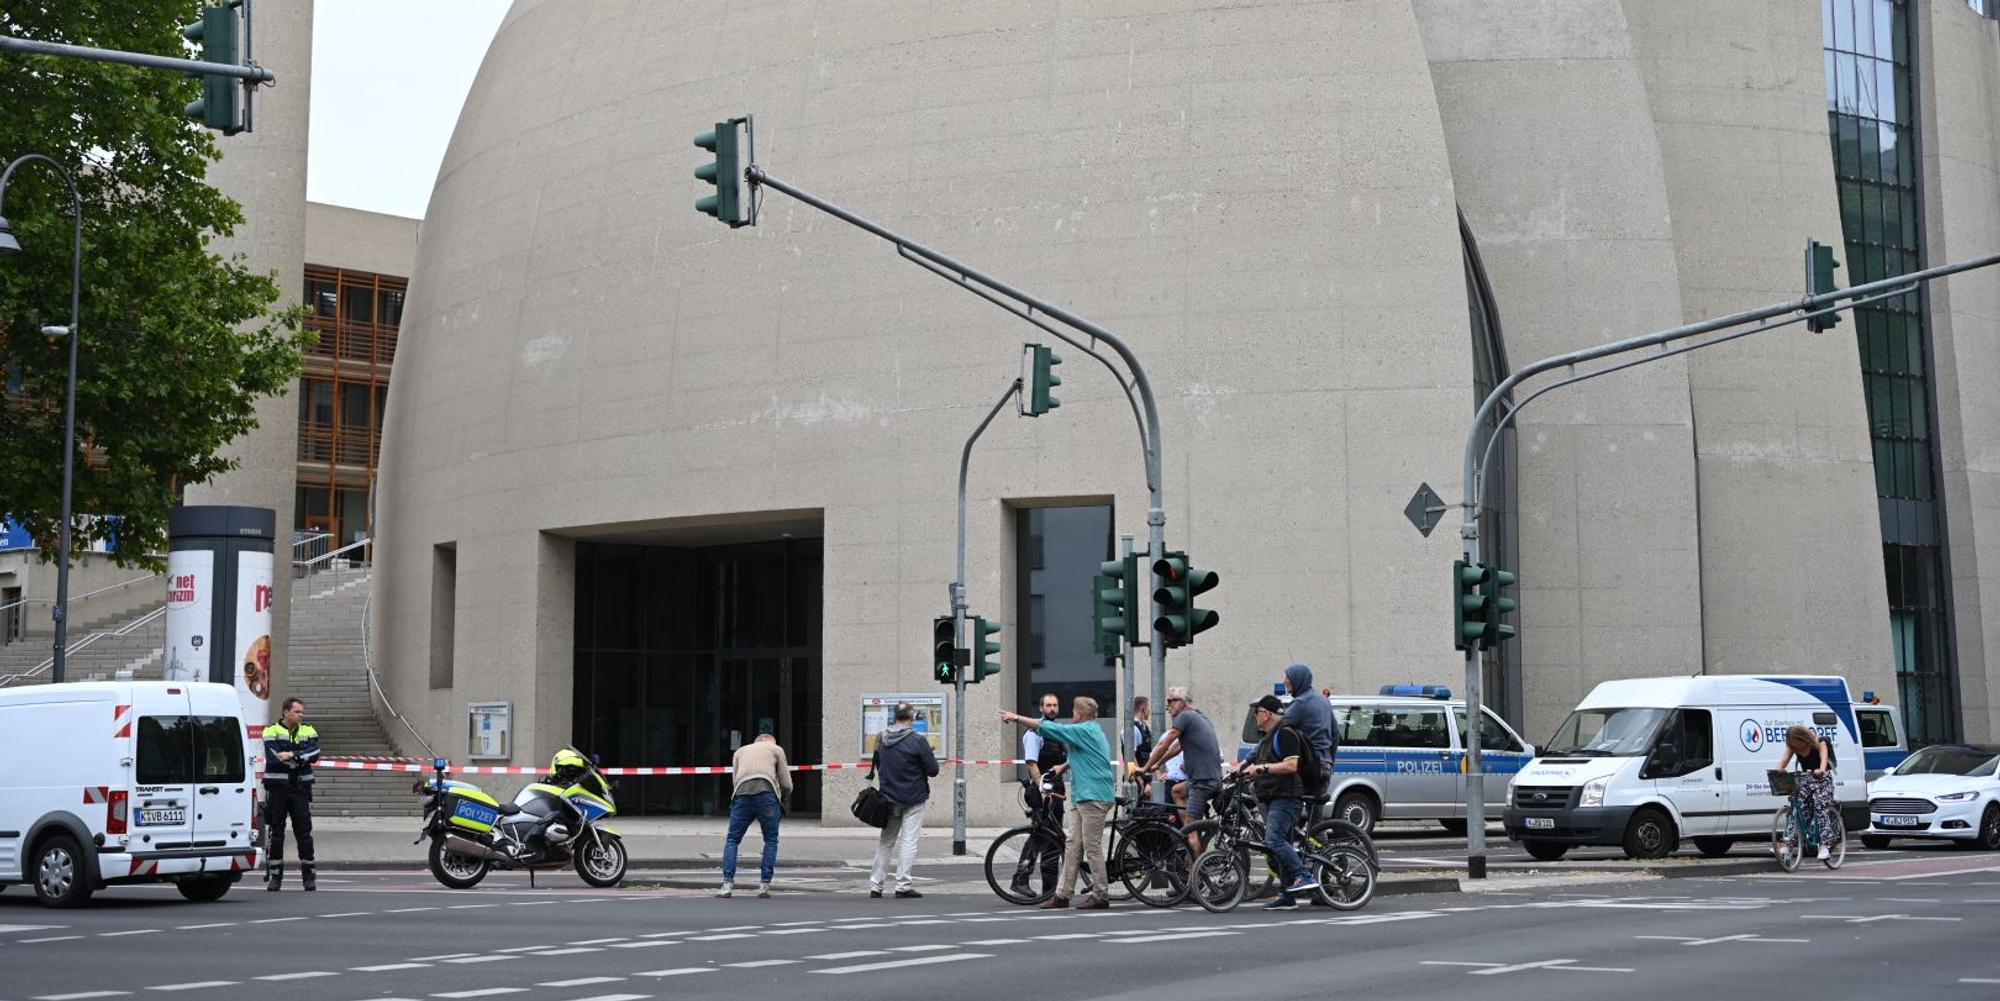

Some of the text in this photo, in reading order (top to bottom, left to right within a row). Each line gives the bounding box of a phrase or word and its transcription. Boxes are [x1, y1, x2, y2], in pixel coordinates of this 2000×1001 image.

[176, 574, 194, 589] net
[1397, 761, 1443, 773] POLIZEI
[151, 812, 163, 821] VB
[163, 811, 184, 821] 6111
